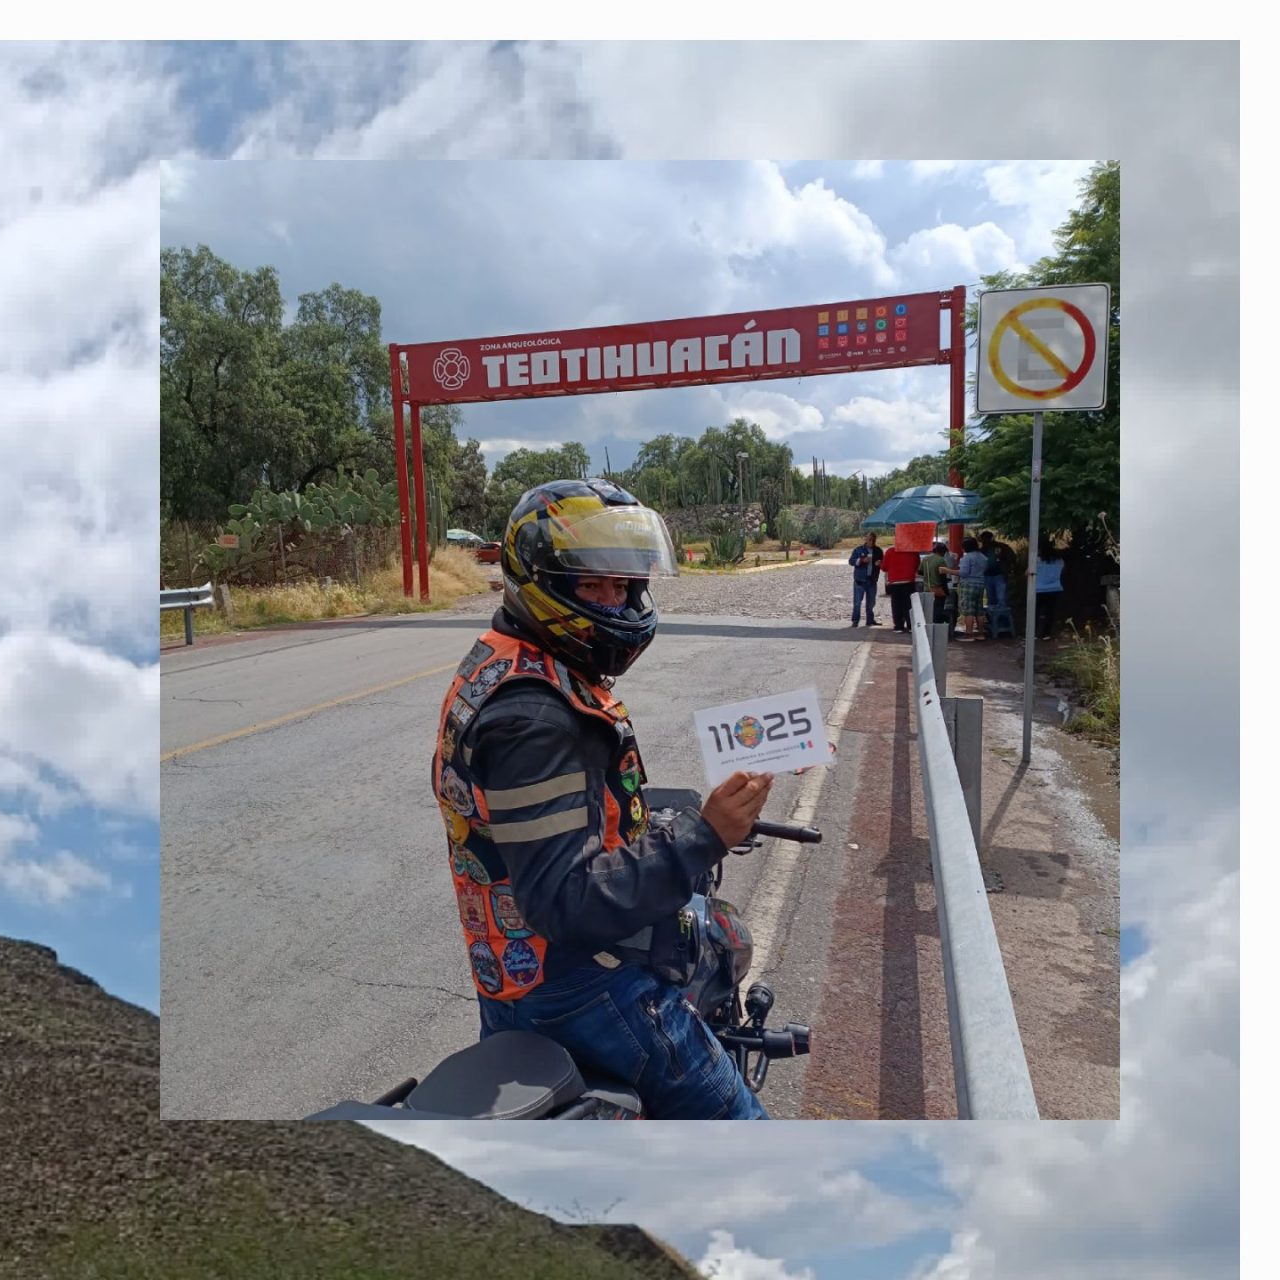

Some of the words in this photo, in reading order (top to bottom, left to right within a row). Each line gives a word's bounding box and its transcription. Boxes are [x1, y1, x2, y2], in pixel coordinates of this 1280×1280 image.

[480, 343, 501, 351] ZONA
[502, 337, 562, 349] ARQUEOLÓGICA
[482, 319, 801, 388] TEOTIHUACÁN
